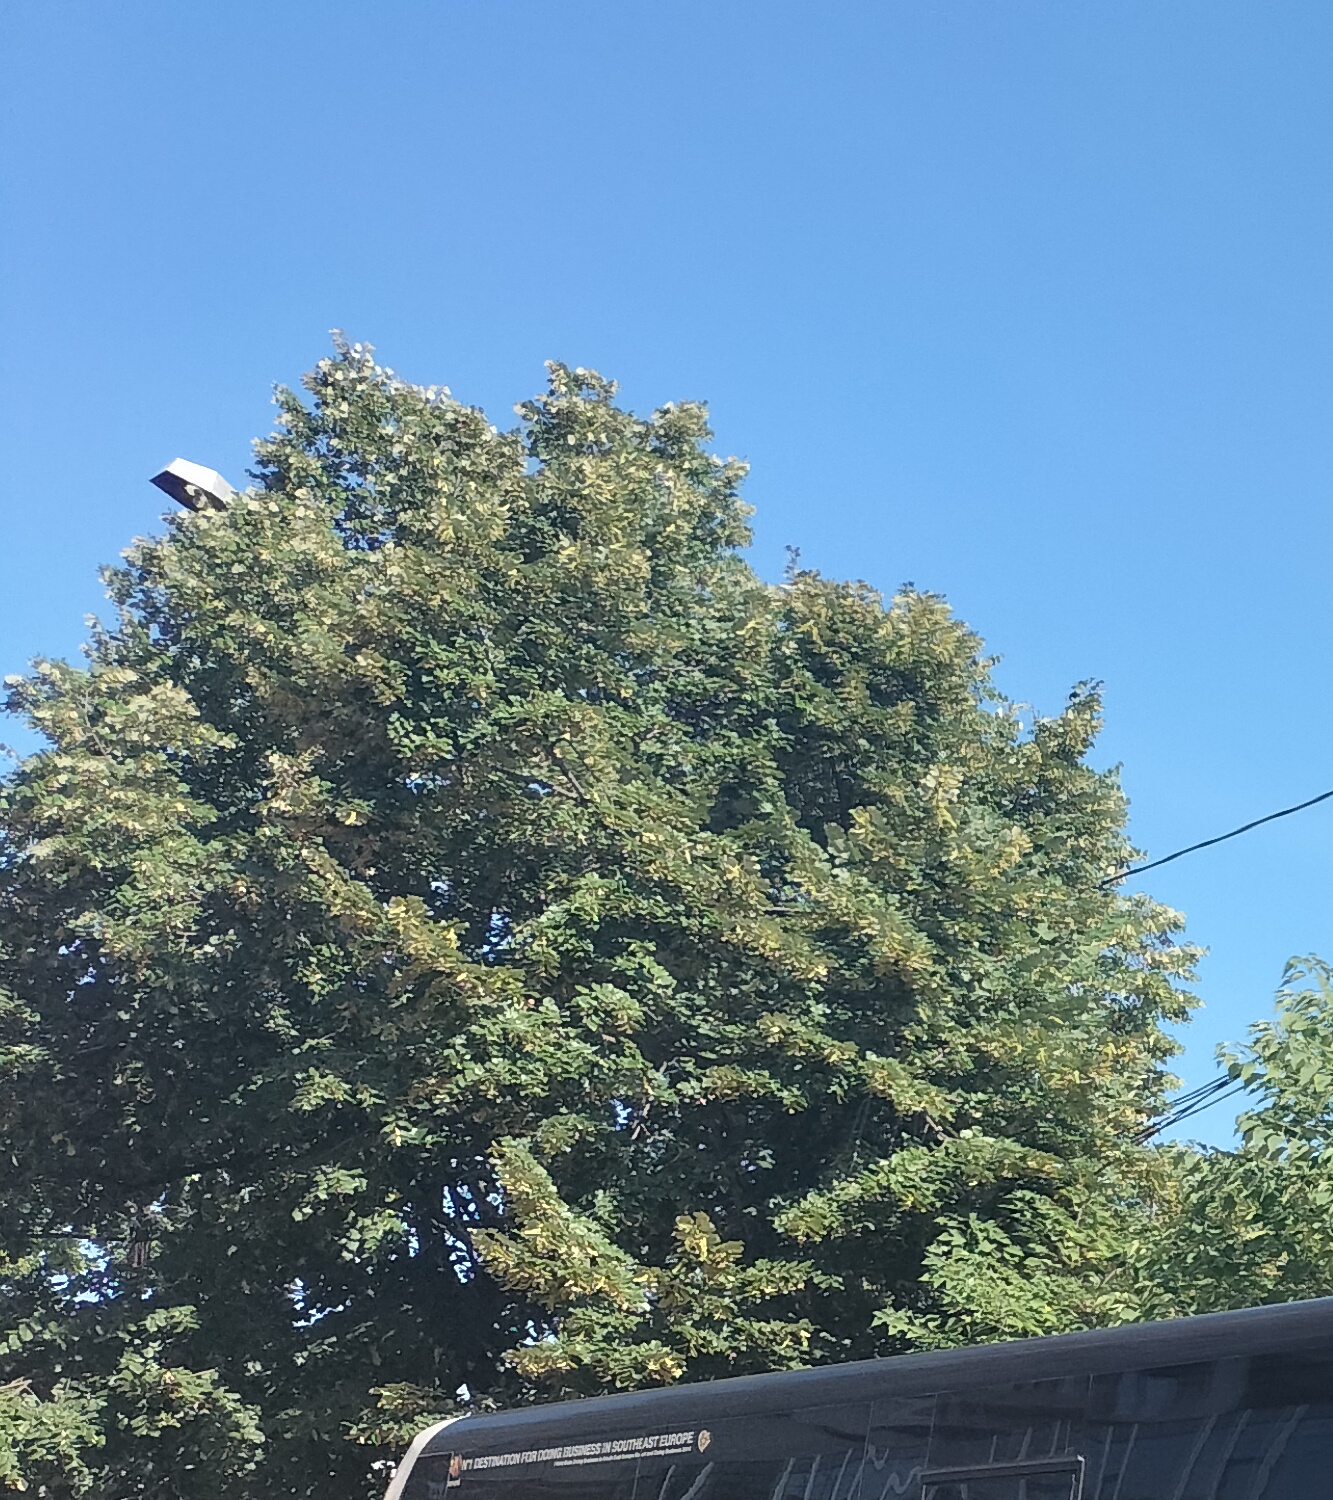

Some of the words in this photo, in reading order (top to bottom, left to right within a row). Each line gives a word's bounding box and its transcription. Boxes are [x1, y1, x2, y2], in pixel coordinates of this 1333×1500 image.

[473, 1452, 521, 1470] DESTINATION
[521, 1450, 537, 1464] FOR
[537, 1447, 563, 1462] DOING
[563, 1442, 601, 1458] BUSINESS
[612, 1435, 659, 1453] SOUTHEAST
[659, 1431, 695, 1448] EUROPE
